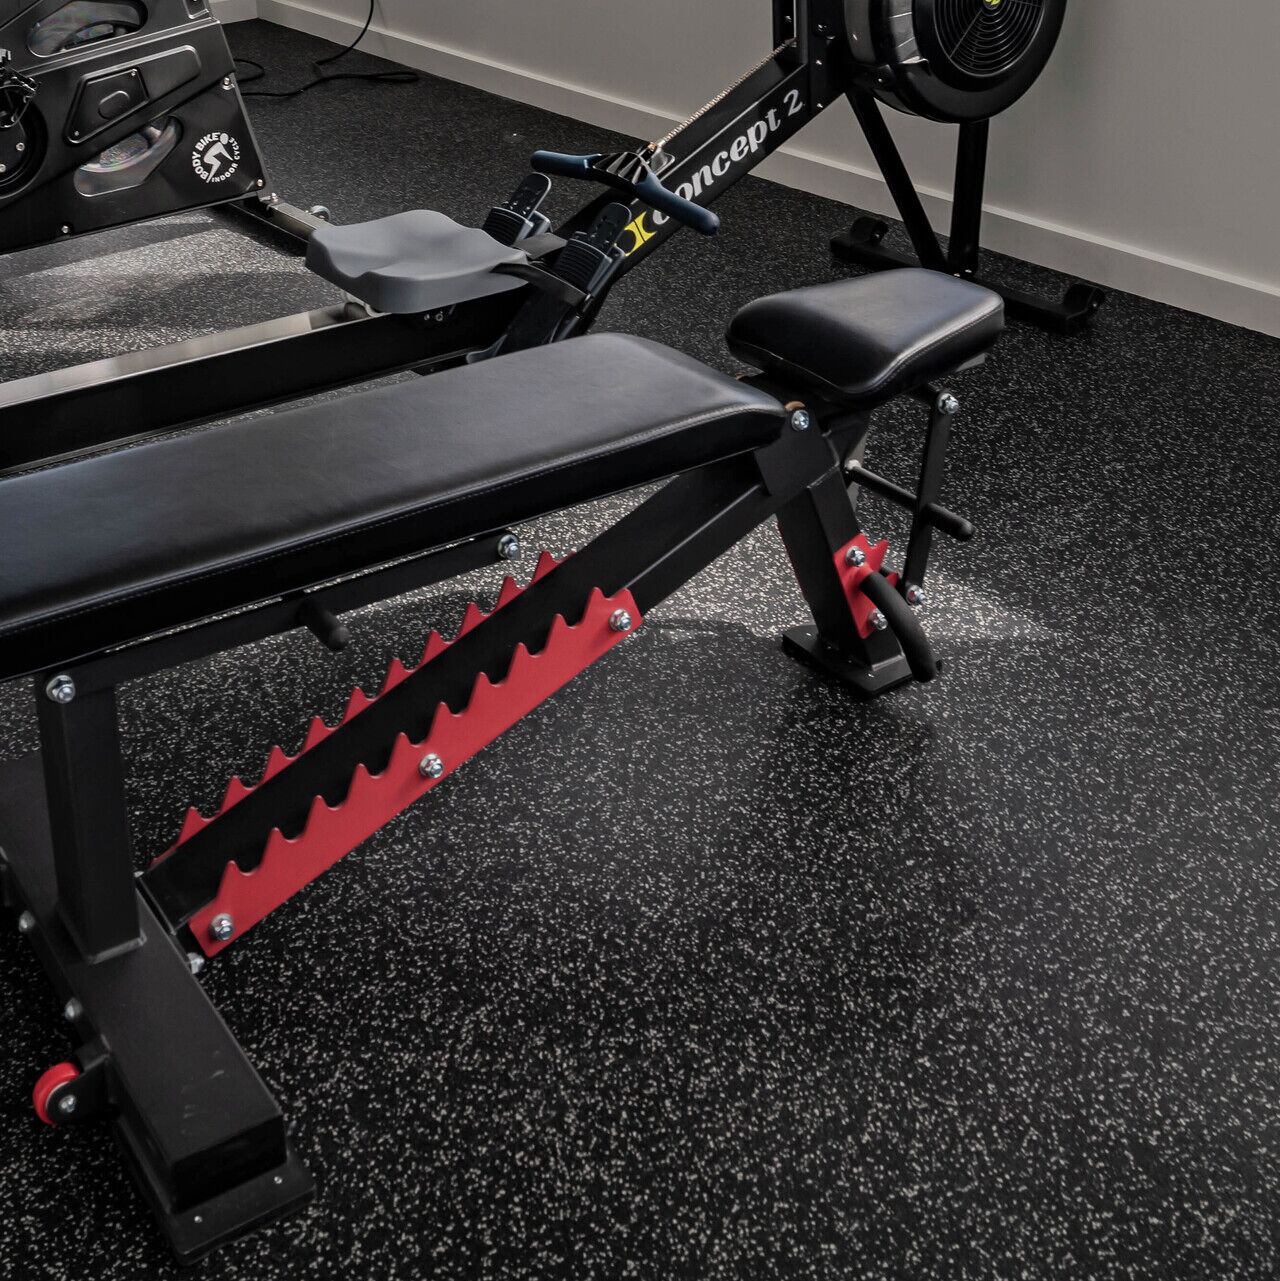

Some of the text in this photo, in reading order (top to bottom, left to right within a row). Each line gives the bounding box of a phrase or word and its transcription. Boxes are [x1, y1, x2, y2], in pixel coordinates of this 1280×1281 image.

[782, 88, 804, 117] 2
[192, 131, 221, 180] BODY BIKE
[211, 136, 241, 183] INDOOR CYCLE
